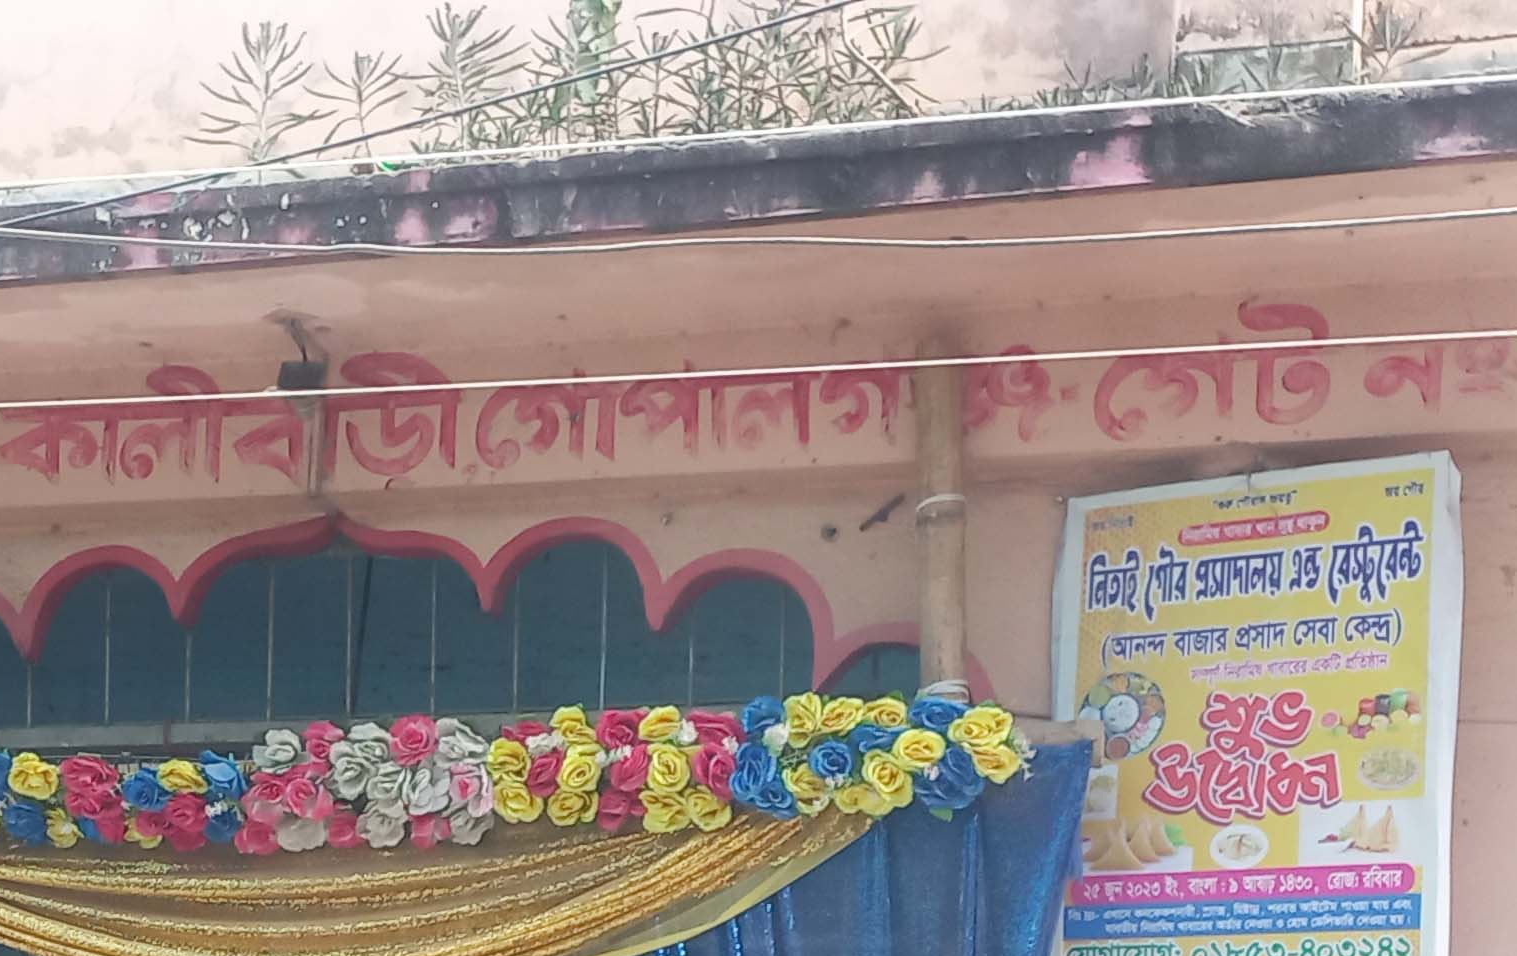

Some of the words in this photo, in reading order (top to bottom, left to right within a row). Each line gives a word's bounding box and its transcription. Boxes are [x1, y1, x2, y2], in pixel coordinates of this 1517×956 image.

[1086, 548, 1139, 613] নিতাই
[1144, 545, 1187, 622] গৌর
[1174, 626, 1230, 657] বাজার
[1234, 619, 1289, 652] প্রসাদ
[1293, 616, 1339, 646] সেবা
[1199, 690, 1314, 760] শুভ
[1126, 881, 1162, 897] ২০২৩
